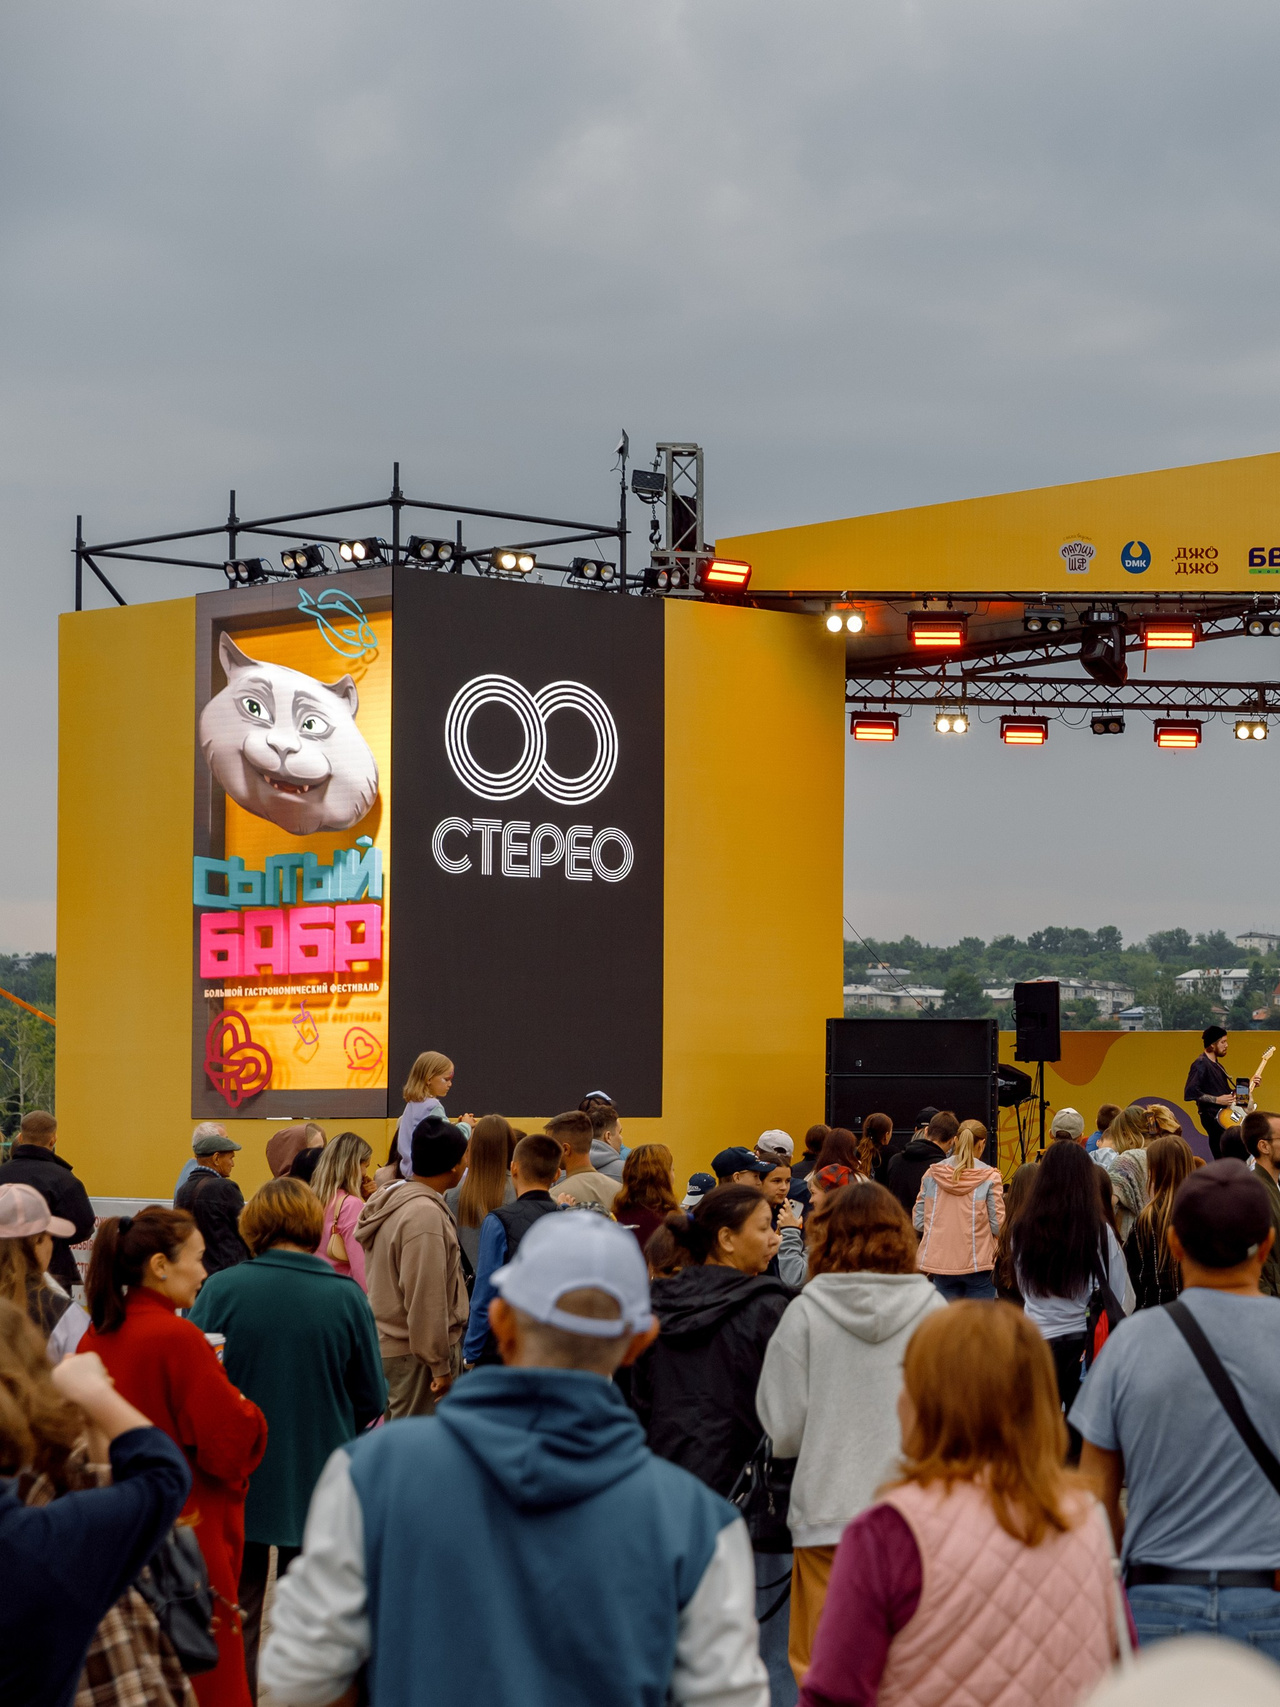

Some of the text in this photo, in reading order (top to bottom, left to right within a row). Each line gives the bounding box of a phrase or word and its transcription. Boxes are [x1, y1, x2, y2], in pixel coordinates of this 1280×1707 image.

[1174, 546, 1219, 560] ДЖО
[1174, 561, 1219, 575] ДЖО
[431, 816, 635, 883] СТЕРЕО
[192, 834, 383, 911] СЫТЫЙ
[200, 903, 382, 979] БАБР
[203, 982, 380, 998] БОЛЬШОЙ ГАСТРОНОМИЧЕСКИЙ ФЕСТИВАЛЬ
